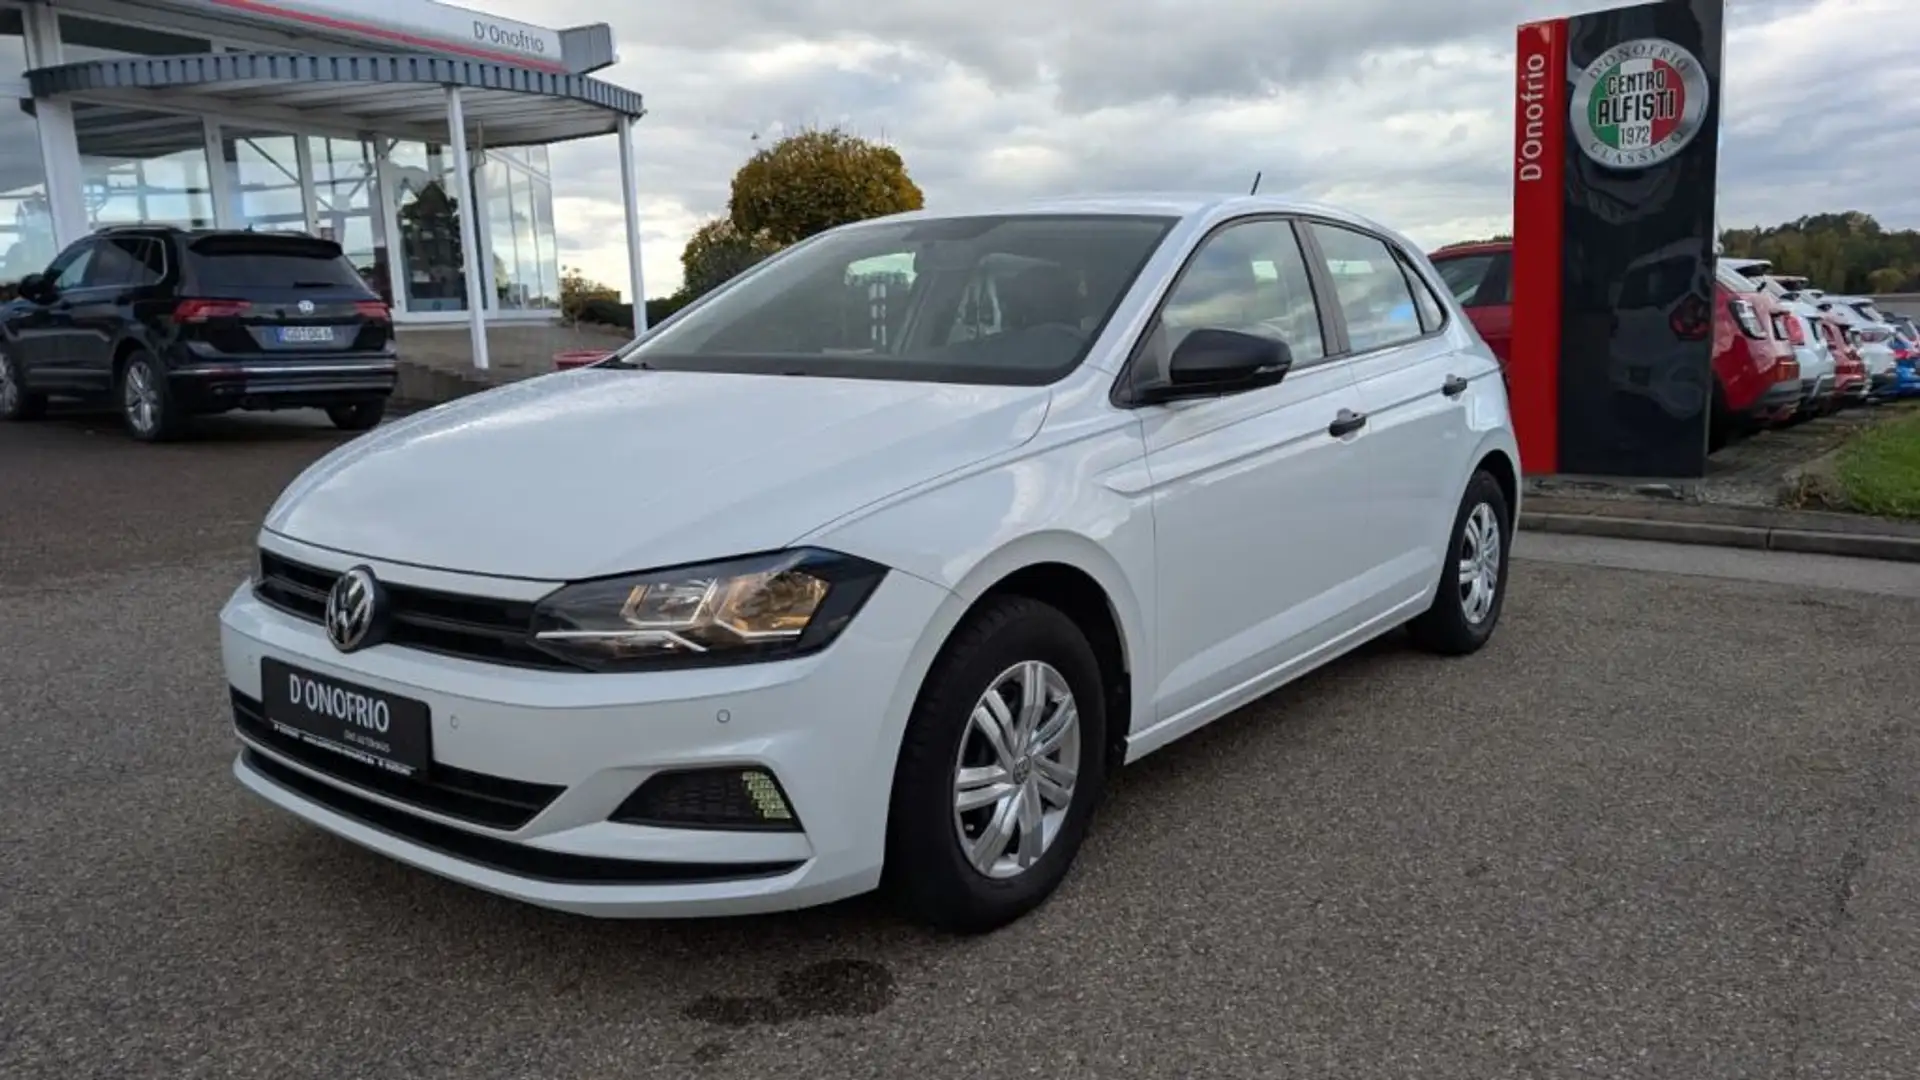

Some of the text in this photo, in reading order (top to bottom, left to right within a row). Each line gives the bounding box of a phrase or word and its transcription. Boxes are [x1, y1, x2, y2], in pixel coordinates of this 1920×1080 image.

[473, 20, 544, 52] D'Onofrio
[1589, 43, 1690, 79] D'ONOFRIO
[1608, 69, 1666, 95] CENTRO
[1519, 53, 1545, 181] D'Onofrio
[1597, 90, 1677, 126] ALFISTI
[1590, 130, 1686, 164] CLASSICO
[1620, 125, 1650, 146] 1972
